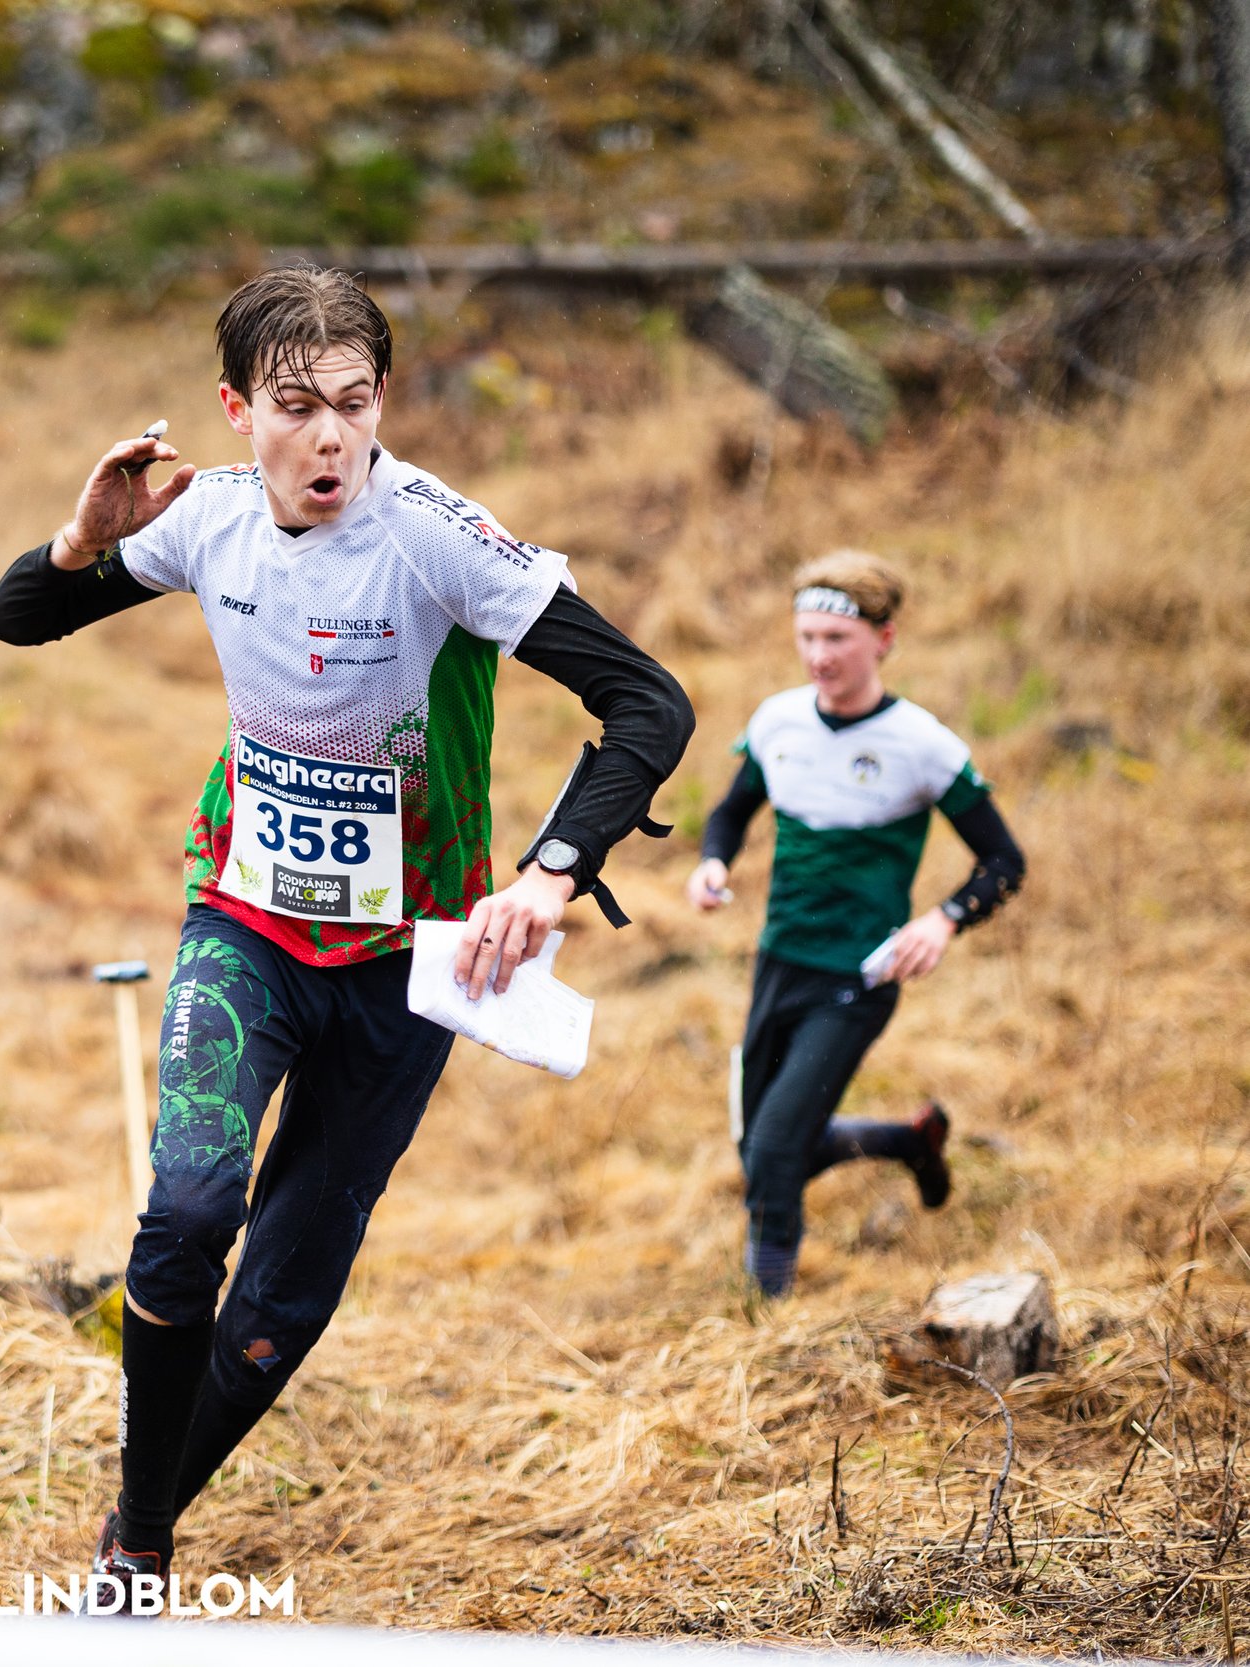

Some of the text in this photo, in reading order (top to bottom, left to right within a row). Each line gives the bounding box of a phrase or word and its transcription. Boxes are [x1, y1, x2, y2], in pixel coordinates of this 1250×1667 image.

[393, 490, 530, 572] MOUNTAIN BIKE RACE
[307, 617, 394, 631] TULLINGE SK
[337, 631, 382, 640] BOTKYRKA
[362, 651, 398, 666] KOMMUN
[238, 738, 394, 795] bagheera
[249, 776, 319, 806] KOLMÅRDSMEDELN
[326, 799, 338, 809] SL
[338, 801, 352, 809] #2
[354, 802, 378, 811] 2026
[256, 801, 371, 865] 358
[277, 871, 342, 891] GODKÄNDA
[287, 900, 321, 910] SVERIGE
[171, 979, 197, 1062] TRIMTEX
